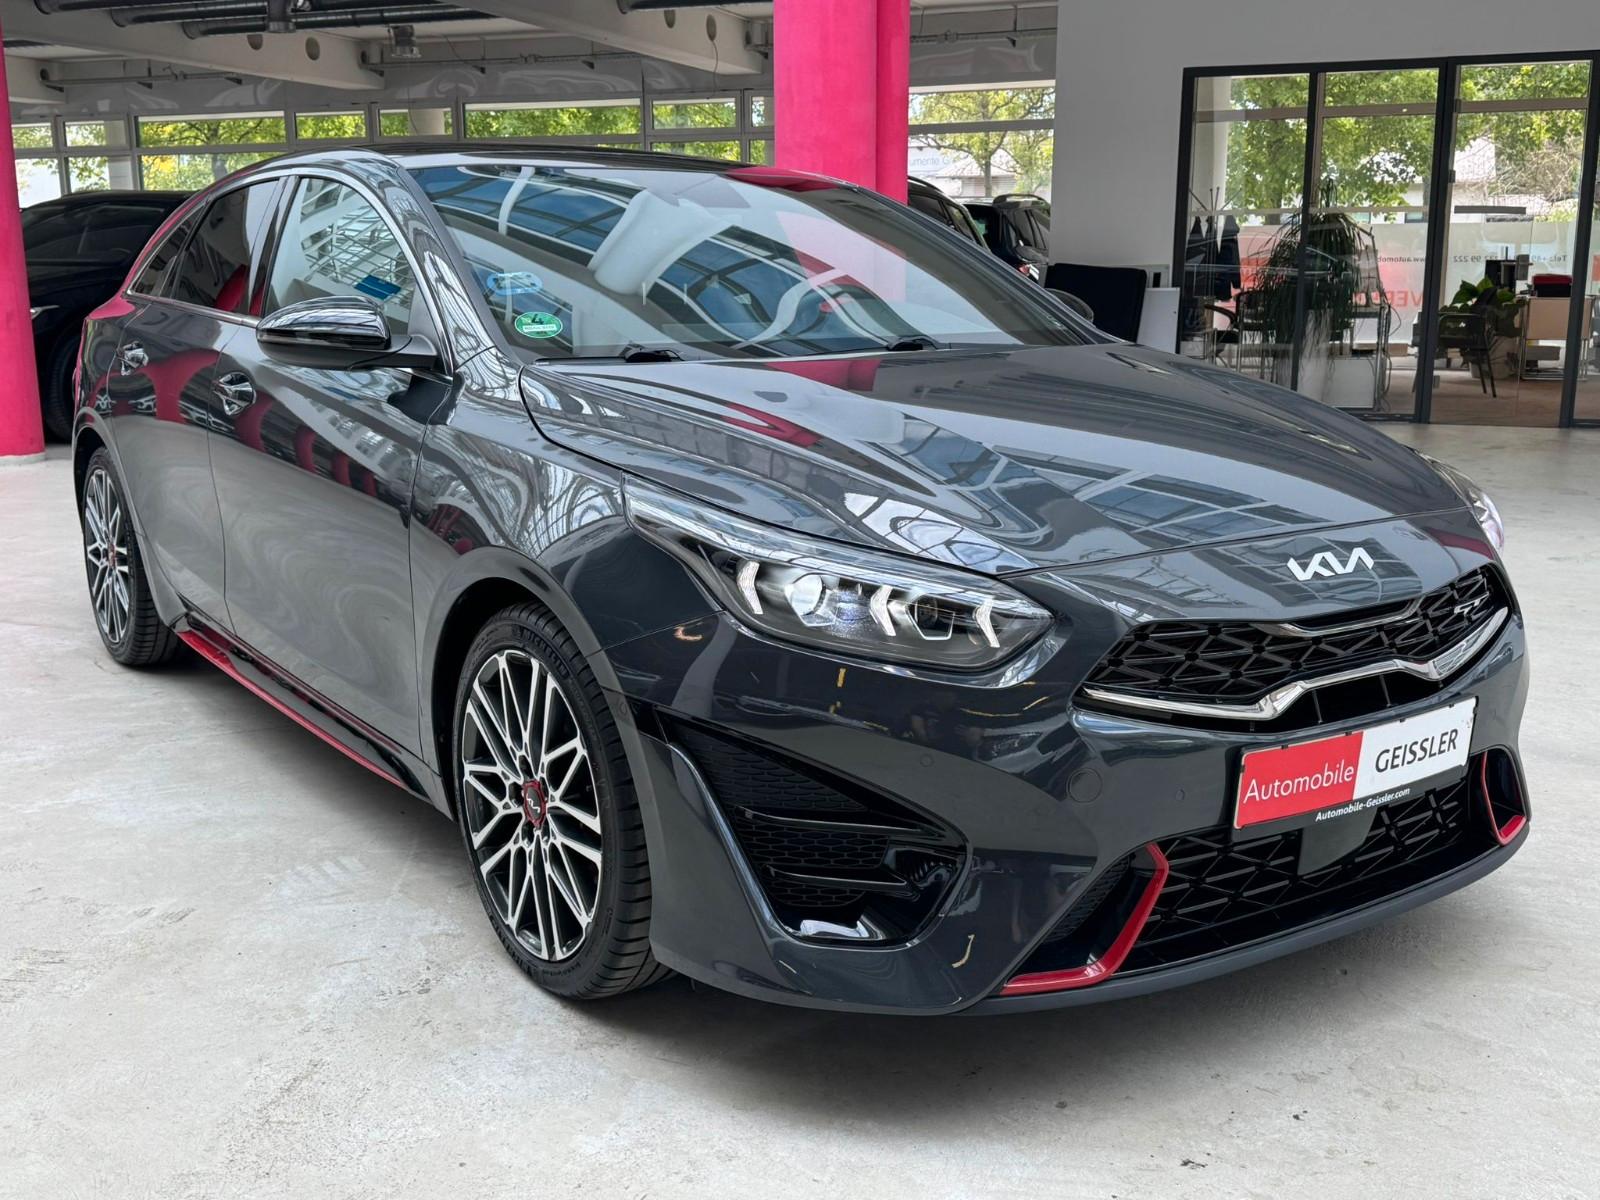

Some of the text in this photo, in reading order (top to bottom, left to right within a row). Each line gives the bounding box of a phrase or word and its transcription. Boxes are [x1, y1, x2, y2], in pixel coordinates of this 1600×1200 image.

[531, 313, 545, 325] 4
[1286, 547, 1375, 581] KIA
[522, 627, 569, 676] MICHELIN
[1242, 728, 1459, 804] Automobile GEISSLER
[1315, 788, 1411, 822] Automobile-Geissler.com
